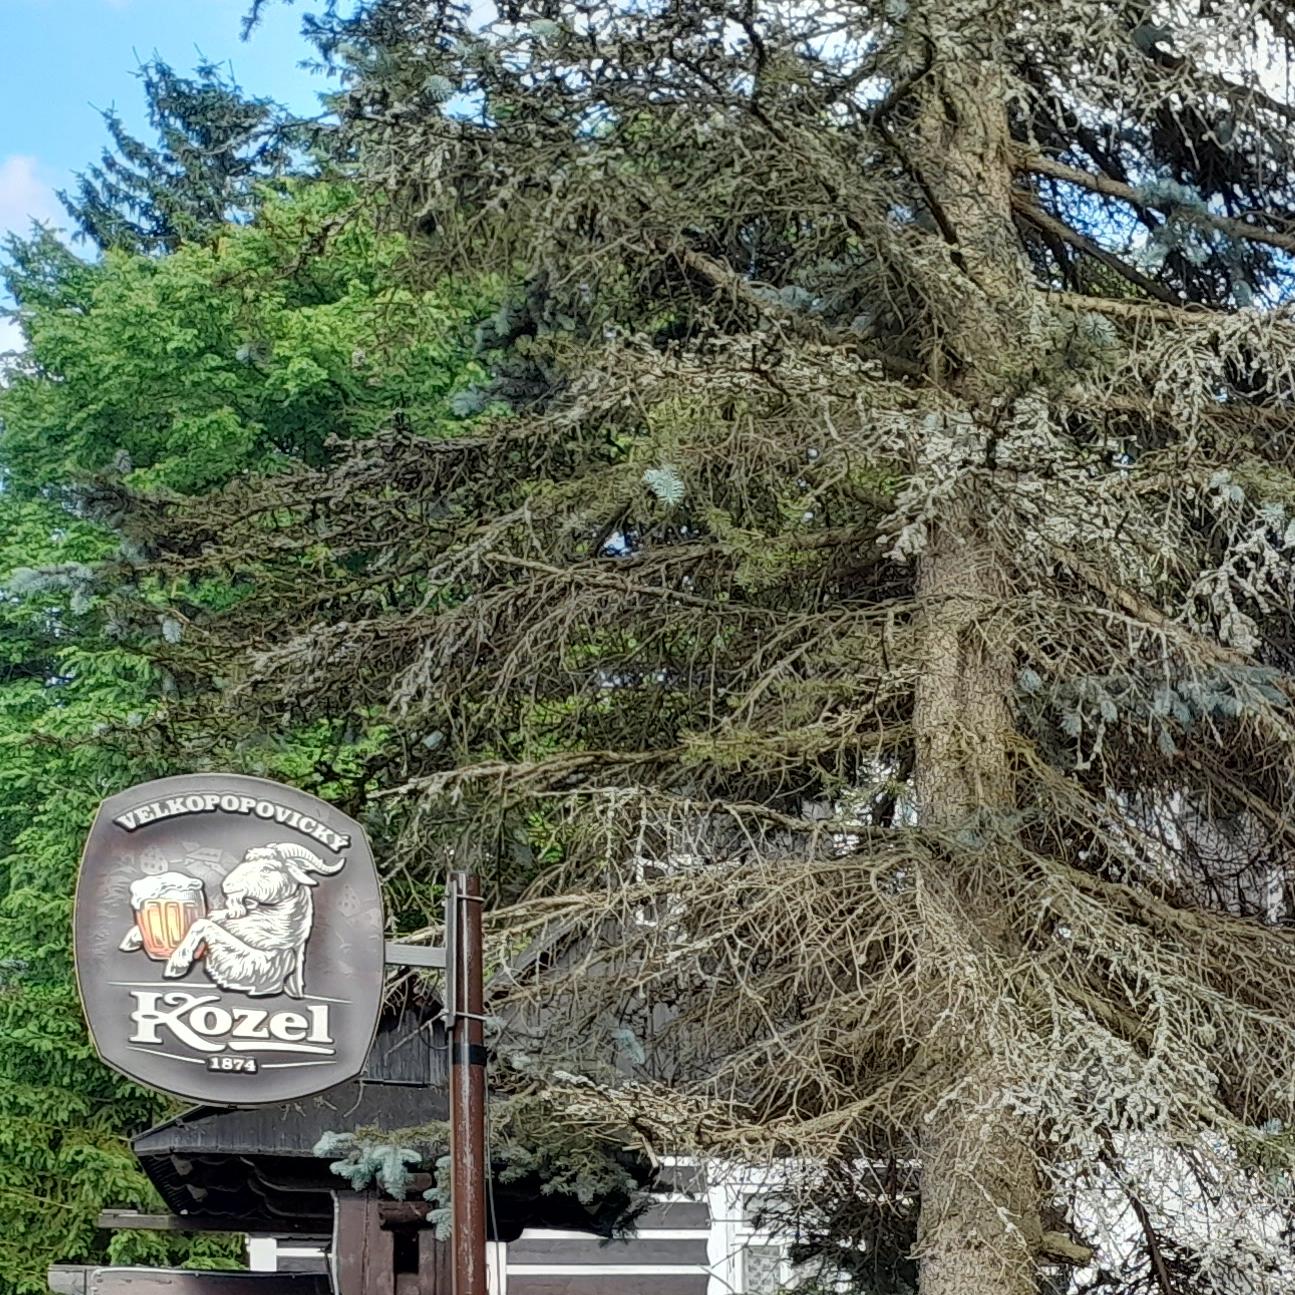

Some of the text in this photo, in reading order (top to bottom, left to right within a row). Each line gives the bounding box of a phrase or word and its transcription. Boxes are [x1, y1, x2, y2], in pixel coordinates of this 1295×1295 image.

[116, 795, 349, 851] VELKOPOPOVICKÝ
[128, 990, 336, 1055] Kozel
[209, 1057, 256, 1072] 1874
